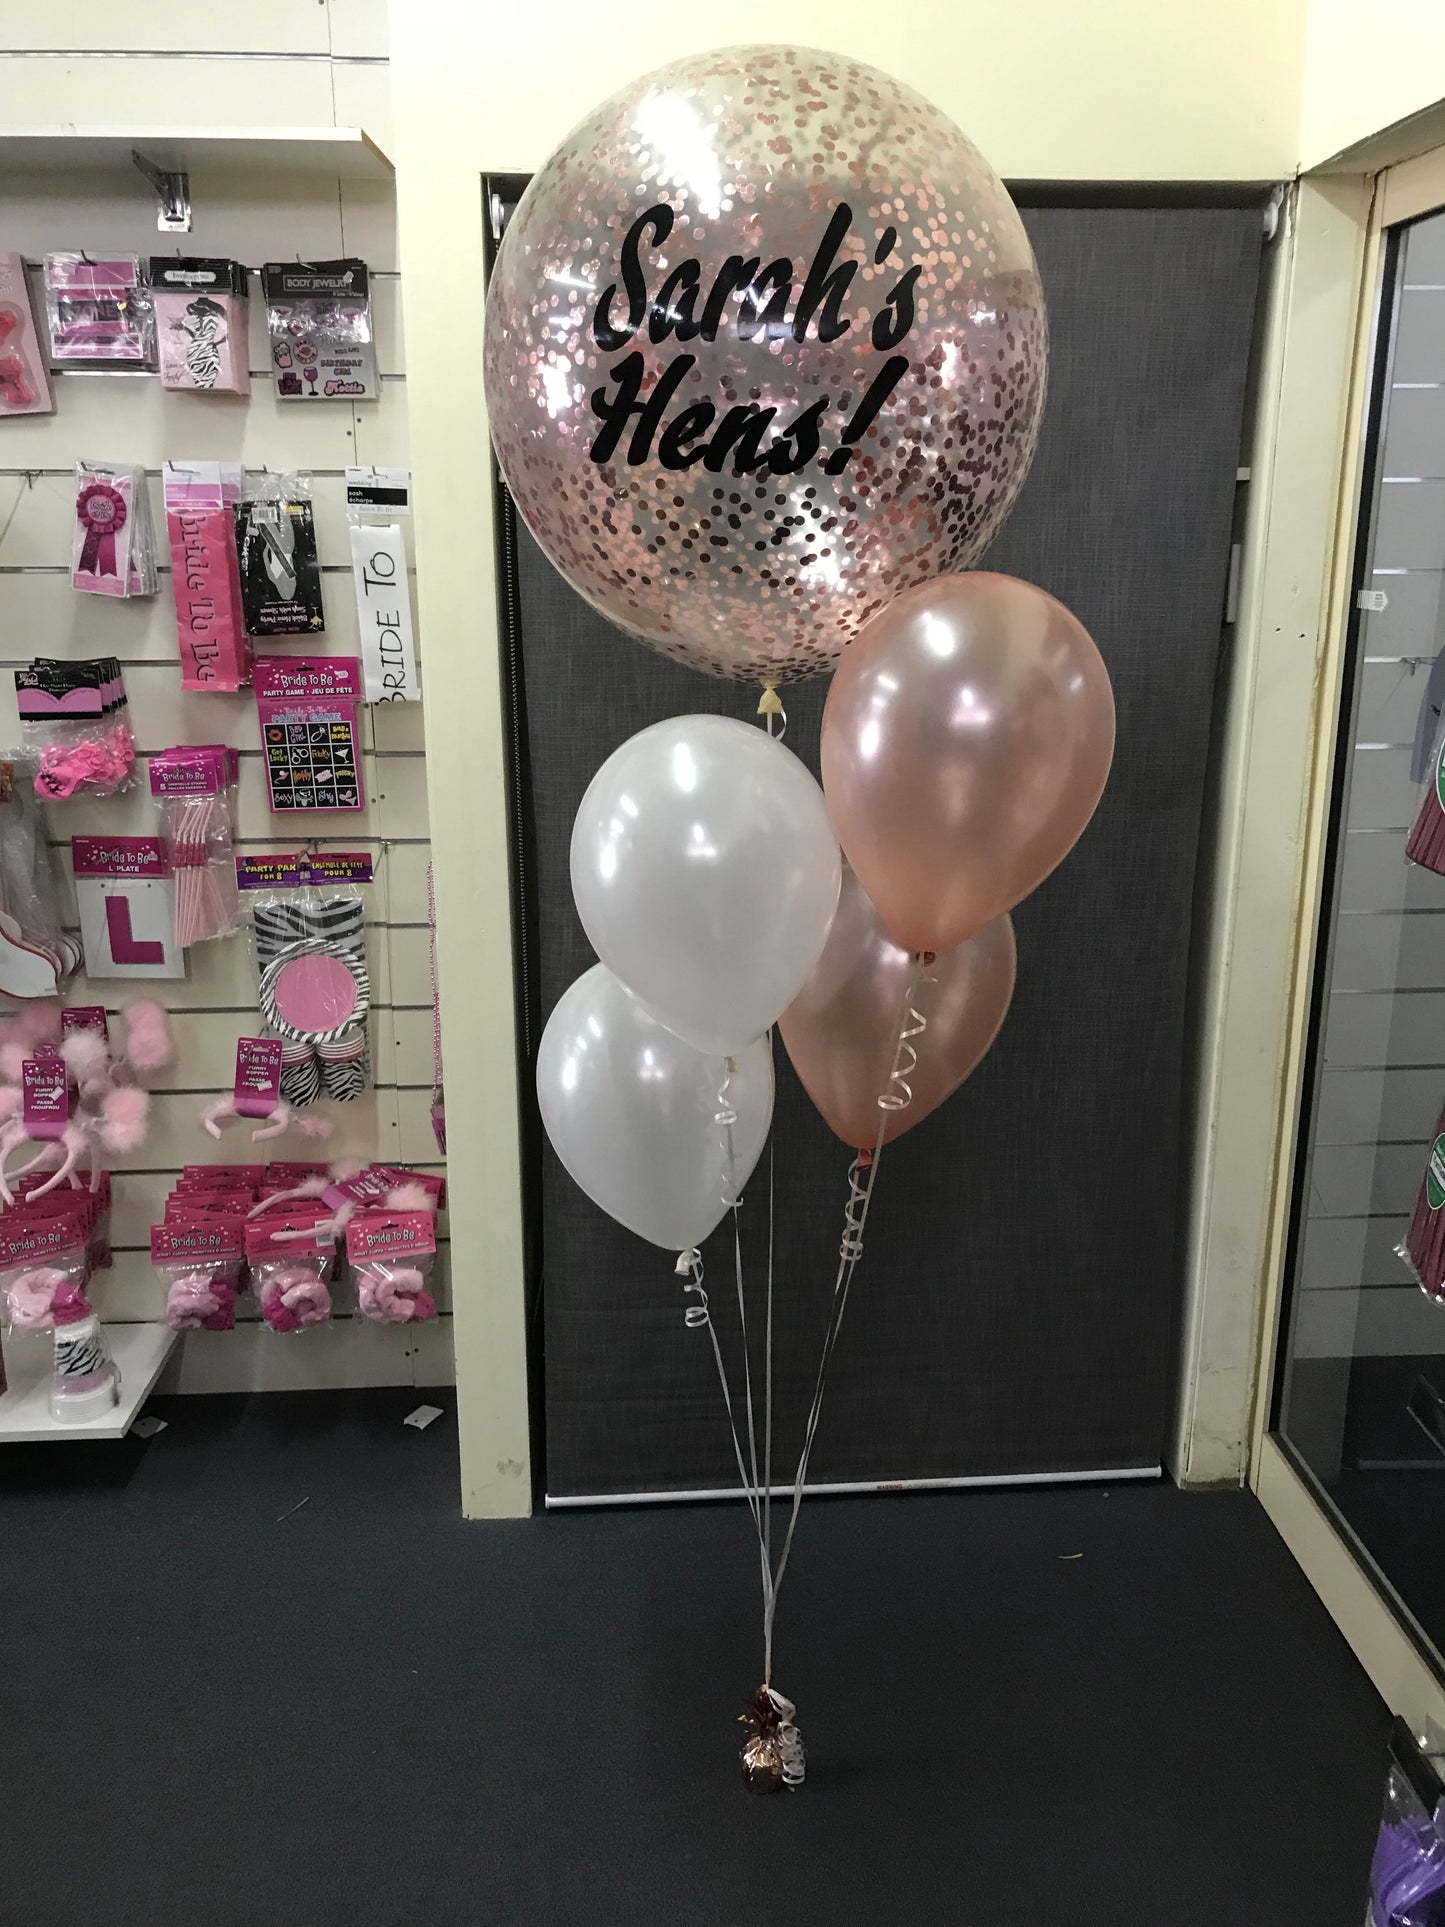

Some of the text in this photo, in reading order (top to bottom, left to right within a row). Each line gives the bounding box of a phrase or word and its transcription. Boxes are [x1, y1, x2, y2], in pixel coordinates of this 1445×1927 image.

[287, 279, 347, 288] BODY JEWELRY
[592, 203, 922, 352] Sarah's
[320, 359, 363, 368] BIRTHDAY
[333, 367, 352, 376] GIRL
[590, 350, 909, 476] Hens!
[178, 509, 209, 592] Bride
[362, 552, 396, 597] TO
[188, 597, 214, 635] To
[190, 638, 220, 682] Be
[281, 673, 333, 688] Bride To Be
[263, 689, 284, 697] PARTY
[336, 686, 353, 694] FÊTE
[271, 712, 342, 723] PARTY GAME
[271, 748, 283, 756] Get
[162, 771, 206, 782] Bride To Be
[160, 783, 167, 791] 5
[273, 792, 294, 805] Sexy
[317, 790, 335, 804] Shy
[100, 851, 149, 864] Bride To Be
[245, 864, 297, 873] PARTY PAK
[341, 861, 349, 869] DE
[276, 872, 282, 880] 8
[346, 869, 353, 877] 8
[104, 895, 164, 964] L
[261, 1055, 268, 1063] To
[269, 1055, 279, 1066] Be
[25, 1076, 64, 1087] Bride To Be
[8, 1233, 61, 1254] Bride To Be
[171, 1234, 221, 1249] Bride To Be
[366, 1229, 415, 1247] Bride To Be
